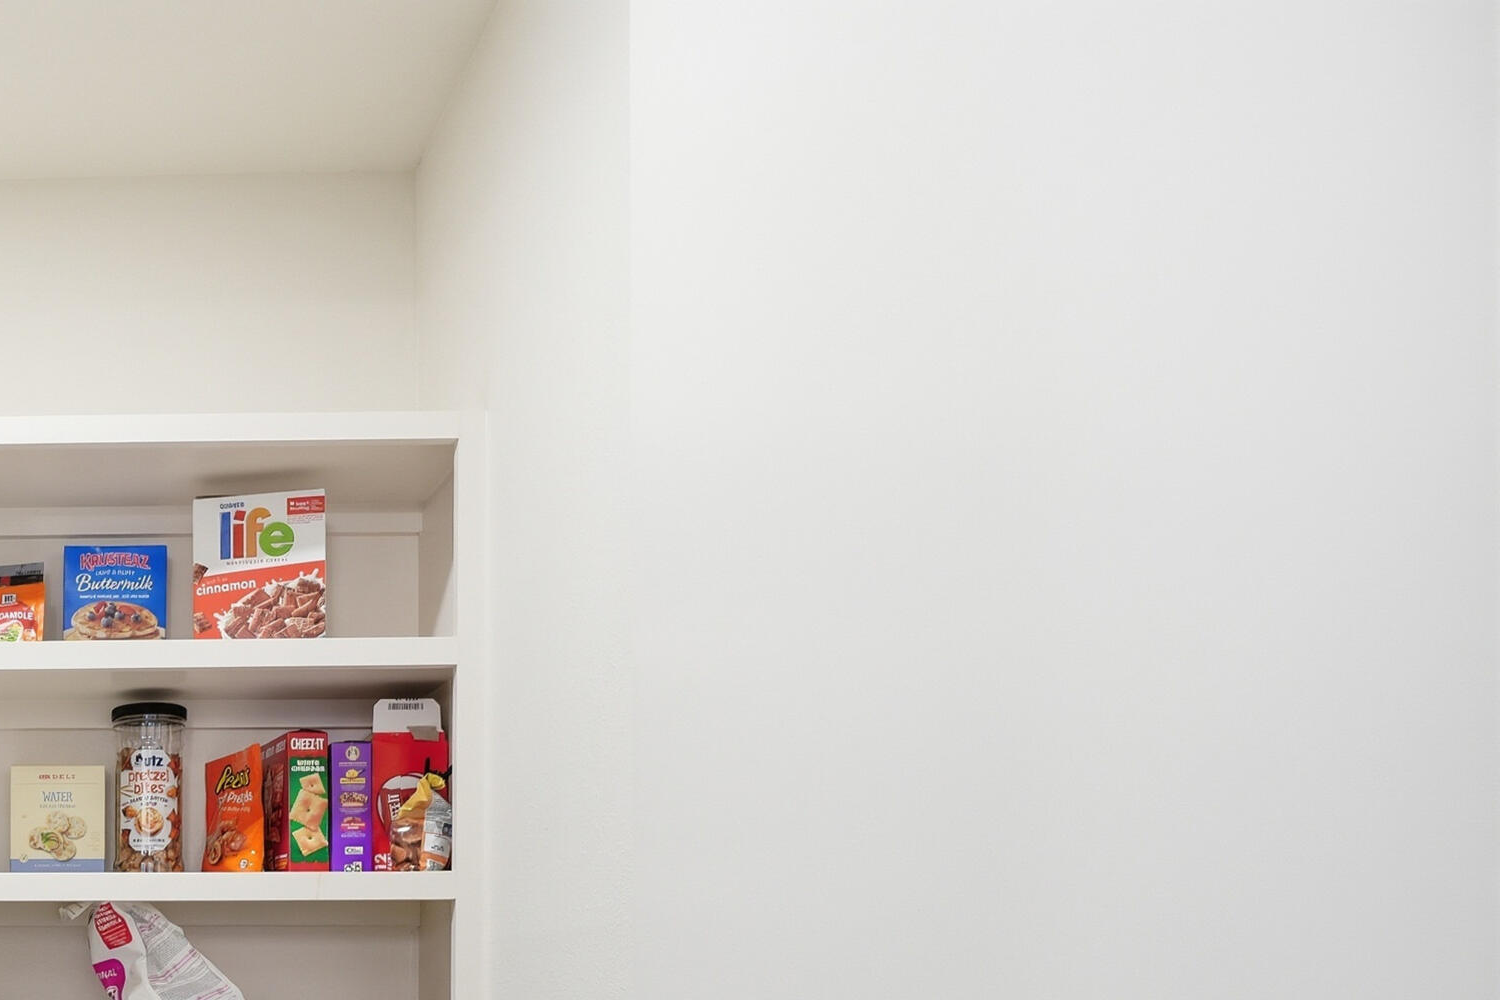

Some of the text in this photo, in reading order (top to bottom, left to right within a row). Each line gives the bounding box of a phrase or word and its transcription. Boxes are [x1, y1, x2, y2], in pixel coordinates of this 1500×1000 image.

[220, 507, 295, 560] life
[80, 552, 151, 571] KRUSTEAZ
[76, 574, 154, 592] Buttermilk
[196, 579, 257, 596] cinnamon
[144, 755, 164, 767] utz
[42, 790, 74, 803] WATER
